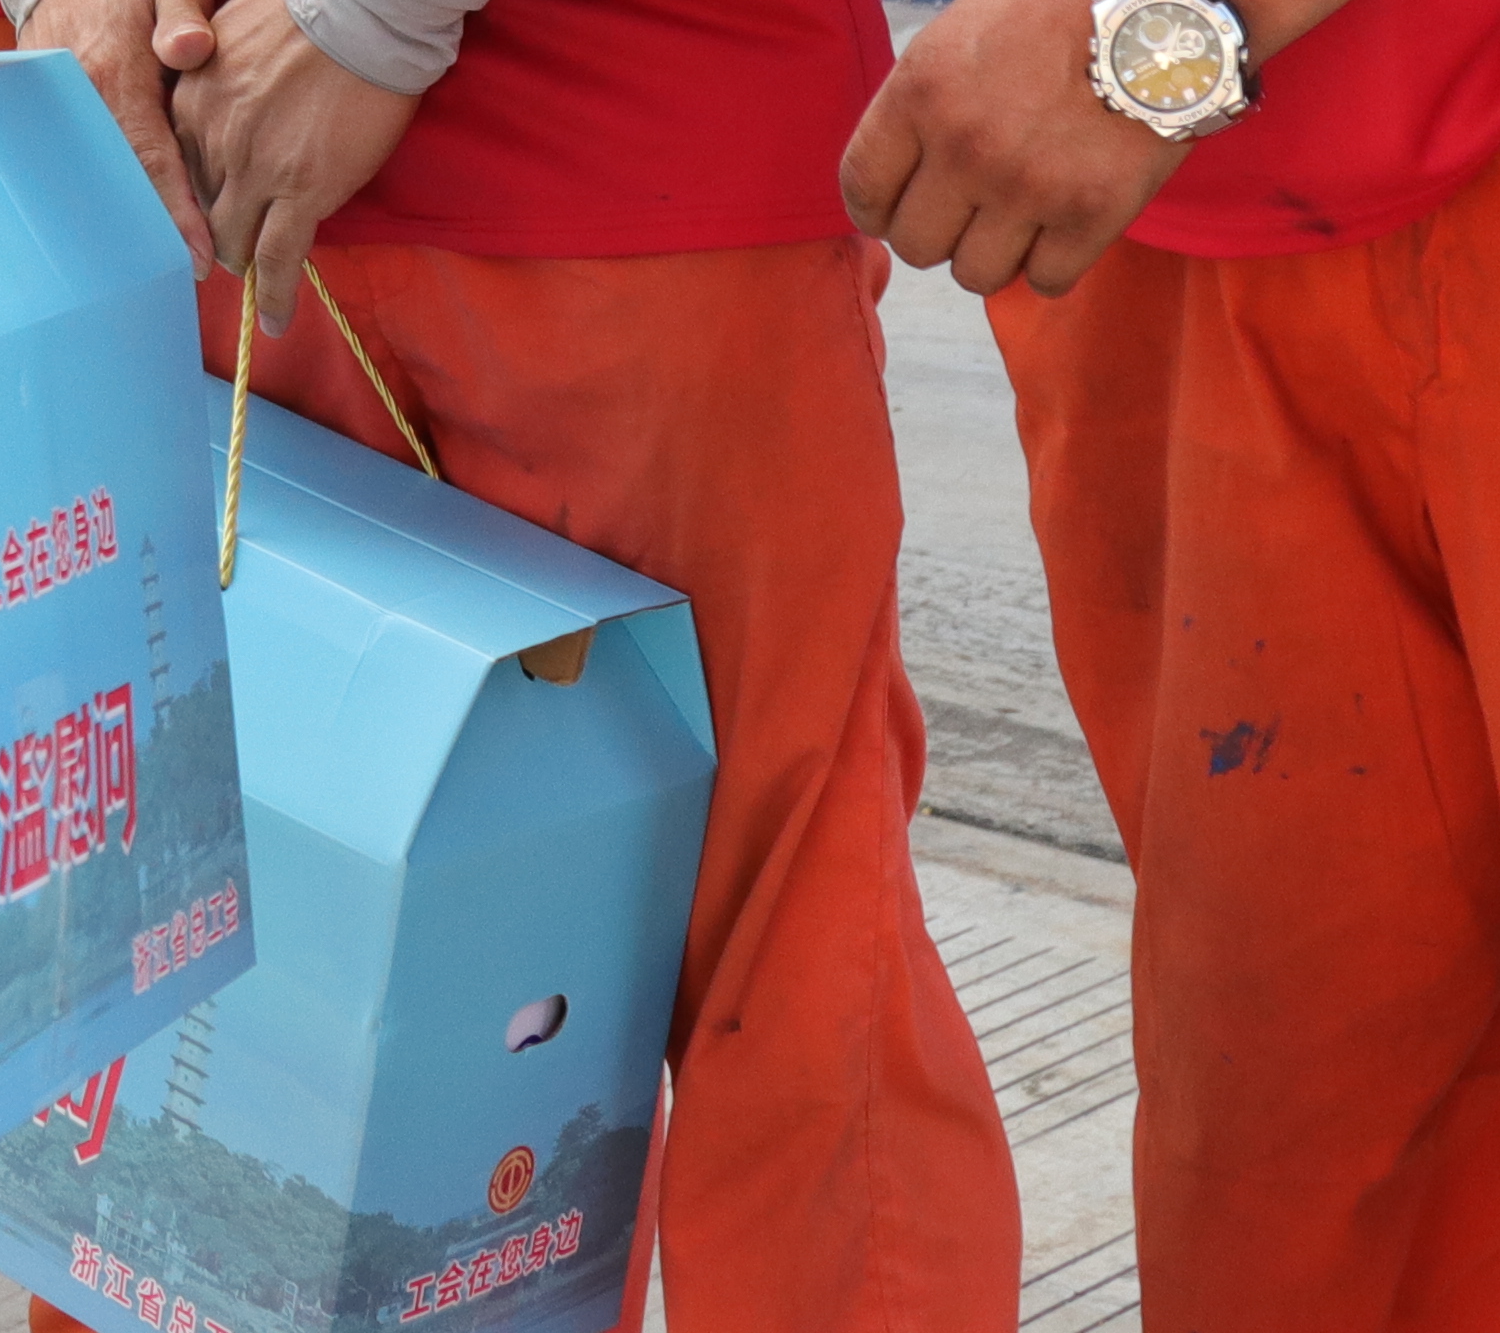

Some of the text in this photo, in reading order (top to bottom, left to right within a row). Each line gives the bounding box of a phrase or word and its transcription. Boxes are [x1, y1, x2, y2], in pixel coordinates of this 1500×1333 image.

[132, 876, 241, 996] 浙江省总工会
[70, 1233, 235, 1333] 浙江省总
[401, 1207, 584, 1324] 工会在您身边
